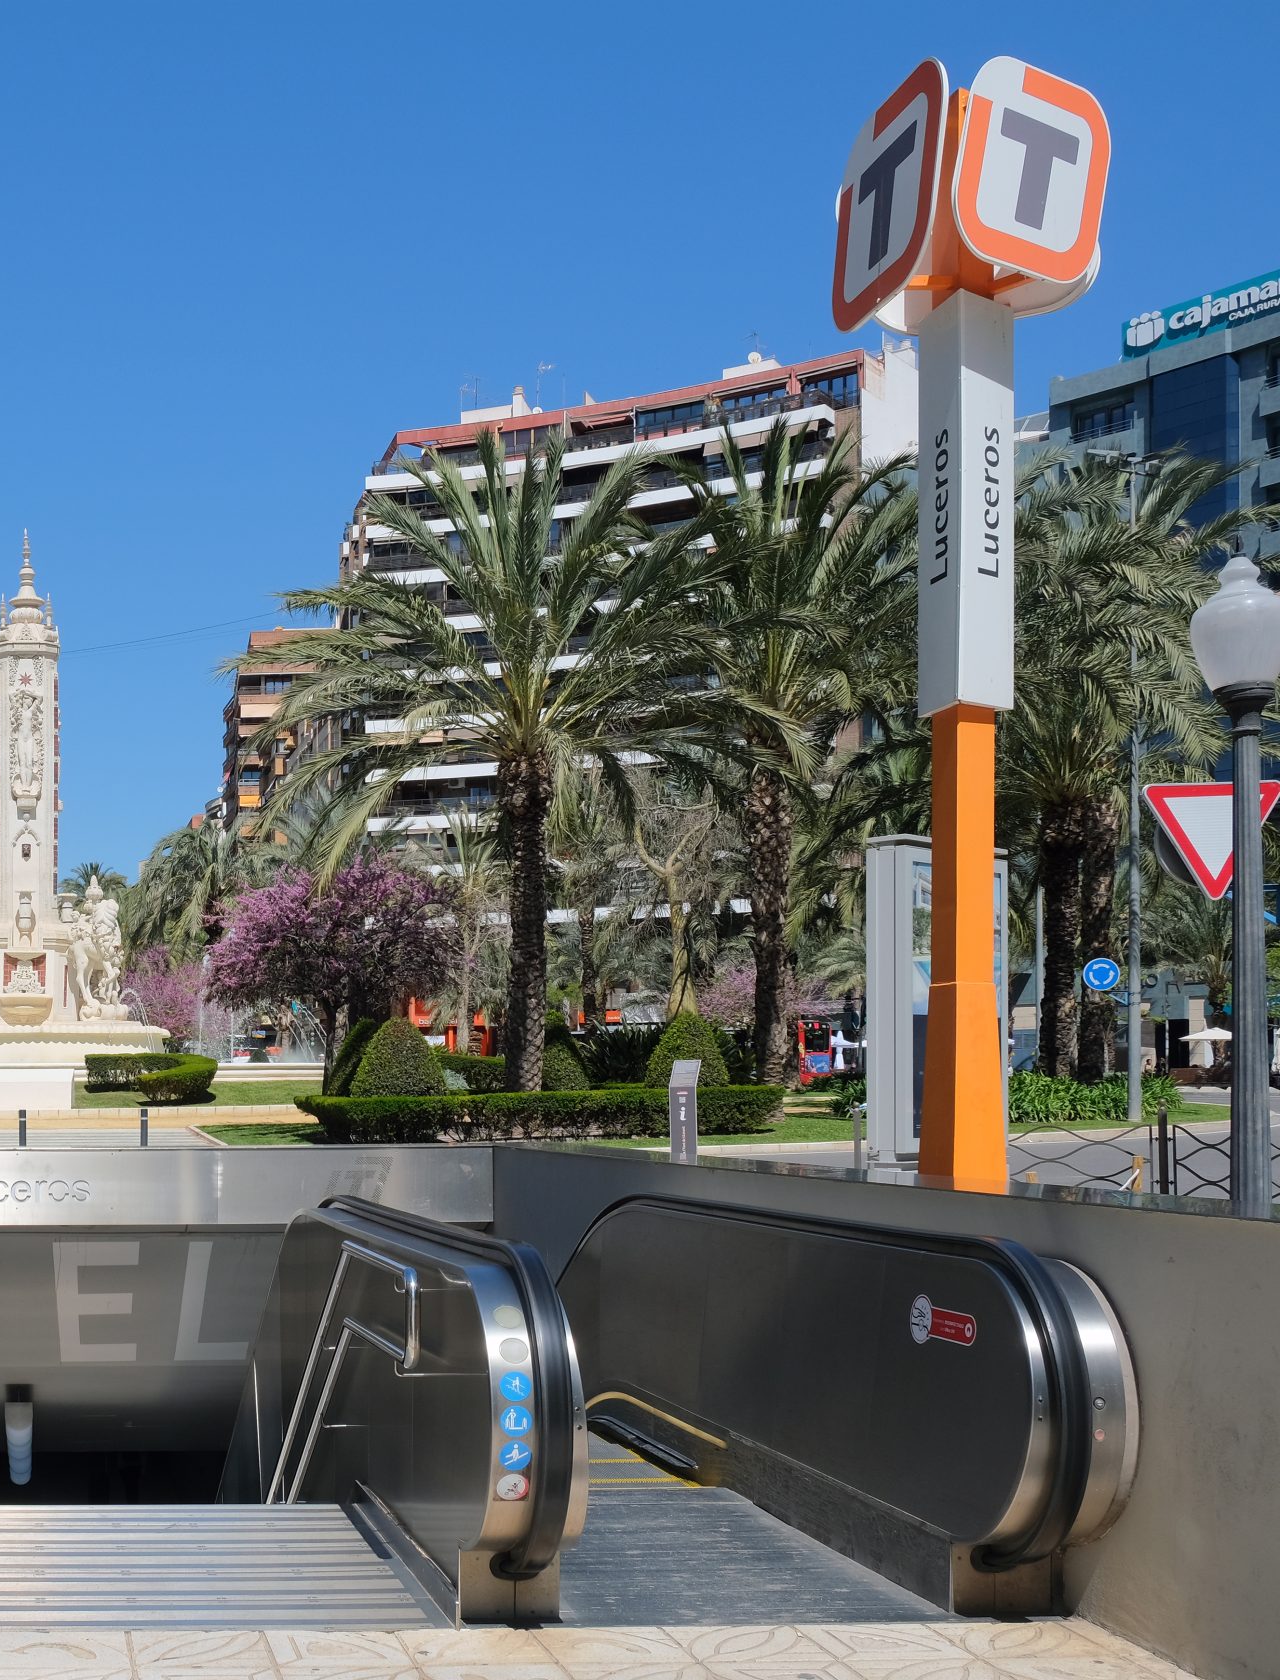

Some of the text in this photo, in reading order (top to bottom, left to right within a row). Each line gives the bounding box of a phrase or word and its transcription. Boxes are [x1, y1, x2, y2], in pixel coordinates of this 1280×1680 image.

[858, 118, 919, 271] T
[1000, 106, 1081, 231] T
[1168, 278, 1280, 330] cajama
[1228, 307, 1255, 321] CAJA
[929, 427, 950, 586] Luceros
[977, 425, 1001, 579] Luceros
